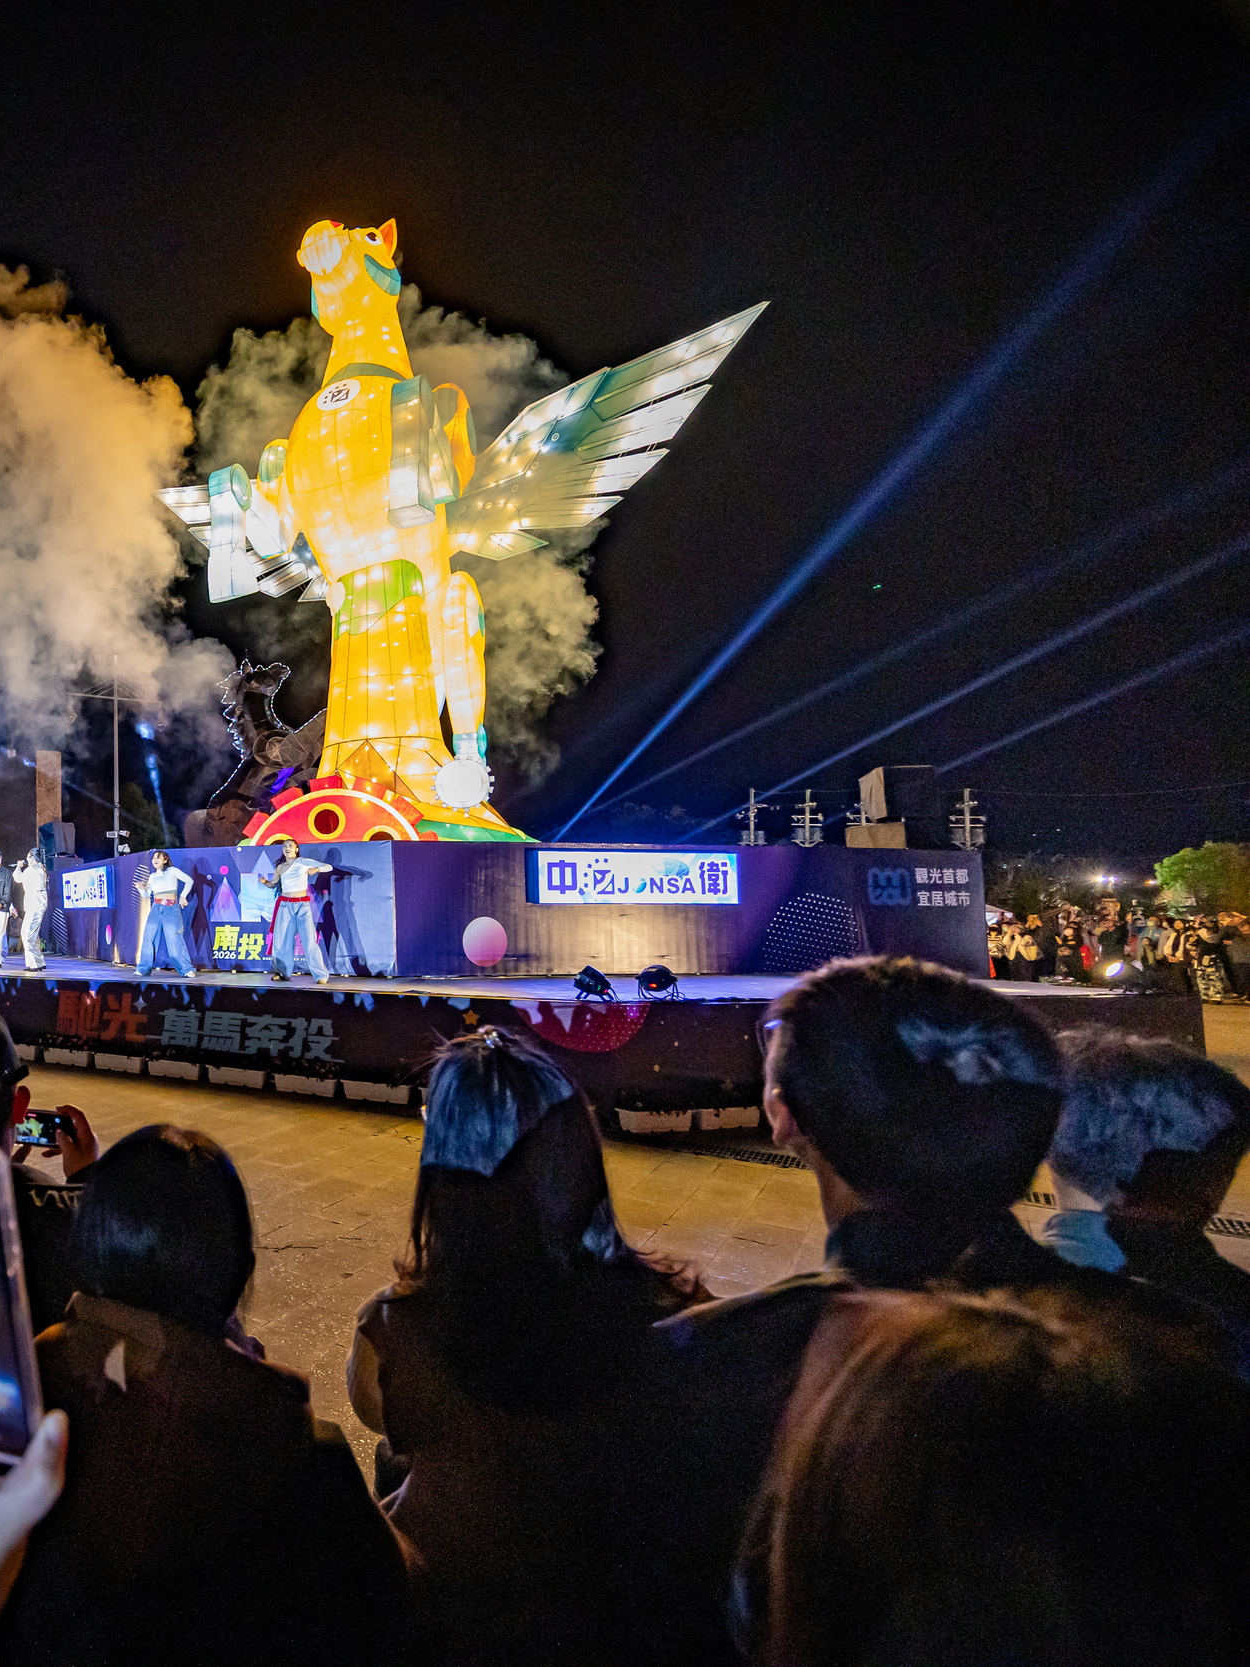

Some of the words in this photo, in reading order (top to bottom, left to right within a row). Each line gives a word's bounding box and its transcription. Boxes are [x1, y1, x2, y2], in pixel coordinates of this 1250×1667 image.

[547, 860, 578, 894] 中
[699, 861, 729, 895] 衛
[915, 867, 969, 884] 觀光首都
[917, 890, 971, 907] 宜居城市
[213, 950, 236, 959] 2026
[56, 989, 148, 1044] 馳光
[159, 1008, 344, 1062] 萬馬奔投
